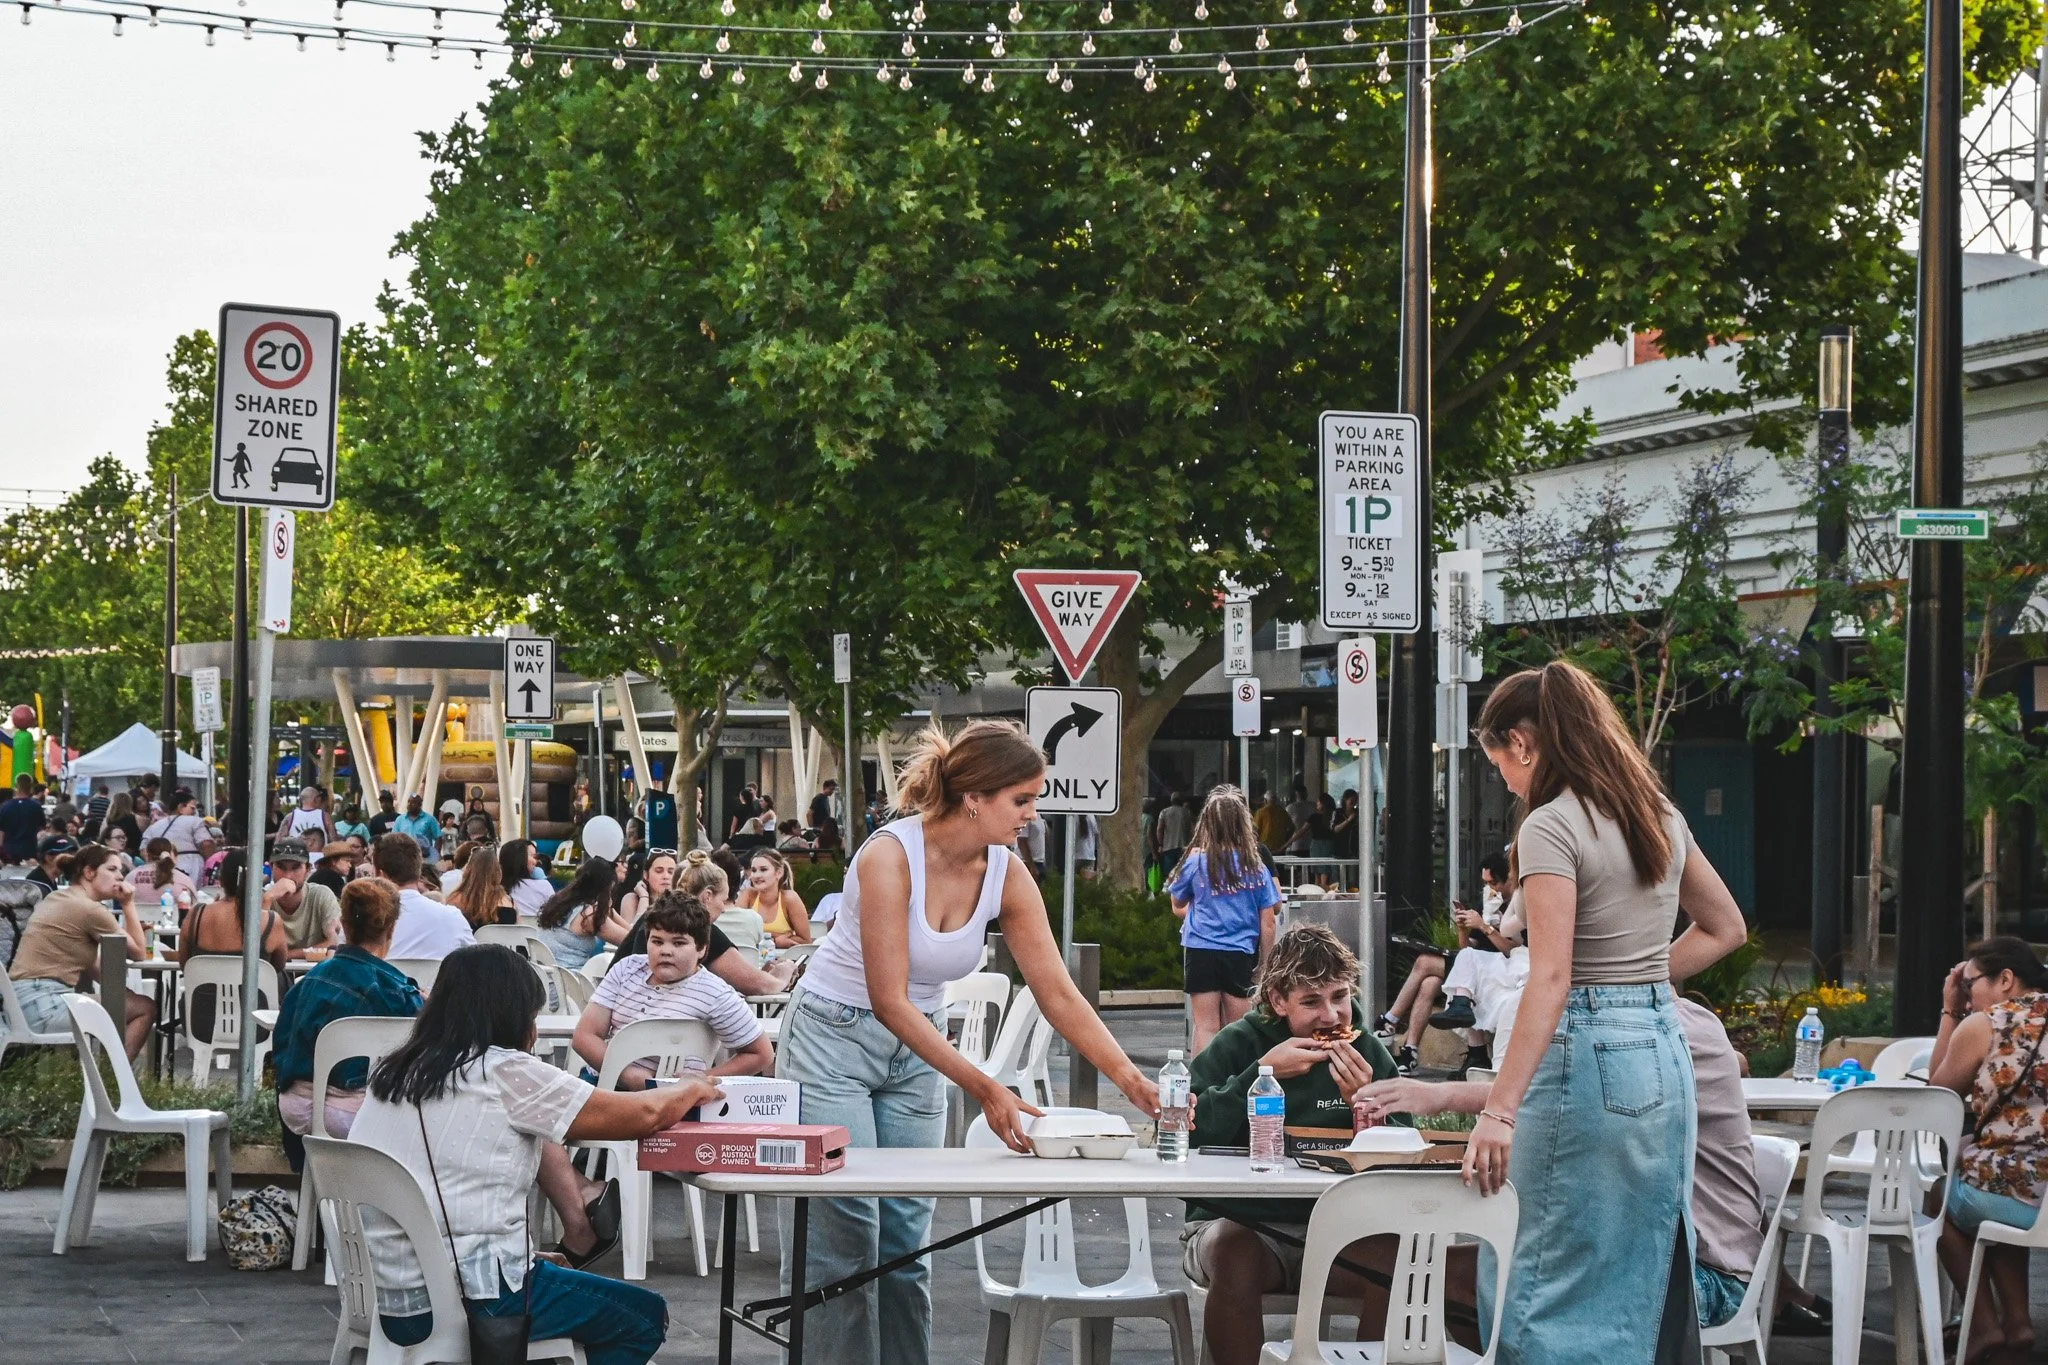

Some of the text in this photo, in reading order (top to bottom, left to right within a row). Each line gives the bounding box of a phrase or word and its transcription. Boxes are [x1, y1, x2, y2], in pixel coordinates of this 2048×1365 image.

[256, 340, 302, 372] 20
[234, 393, 318, 417] SHARED
[247, 419, 303, 440] ZONE
[1334, 425, 1404, 441] YOU ARE
[1335, 442, 1404, 458] WITHIN A
[1335, 459, 1404, 475] PARKING
[1348, 477, 1392, 491] AREA
[1345, 496, 1392, 534] 1P
[1916, 525, 1969, 535] 36300019
[1347, 537, 1392, 551] TICKET
[1051, 591, 1103, 608] GIVE
[1058, 612, 1094, 627] WAY
[1232, 607, 1244, 619] END
[1330, 611, 1412, 621] EXCEPT AS SIGNED
[1233, 622, 1243, 642] 1P
[515, 644, 544, 657] ONE
[514, 661, 545, 674] WAY
[1230, 659, 1247, 671] AREA
[656, 802, 665, 816] P
[743, 1094, 787, 1104] GOULBURN
[1316, 1098, 1346, 1109] REAL
[748, 1103, 783, 1116] VALLEY
[721, 1144, 755, 1152] PROUDLY
[1296, 1141, 1310, 1150] Get
[1310, 1142, 1317, 1150] A
[1317, 1143, 1334, 1151] Slice
[698, 1151, 713, 1160] spc
[721, 1158, 750, 1166] OWNED
